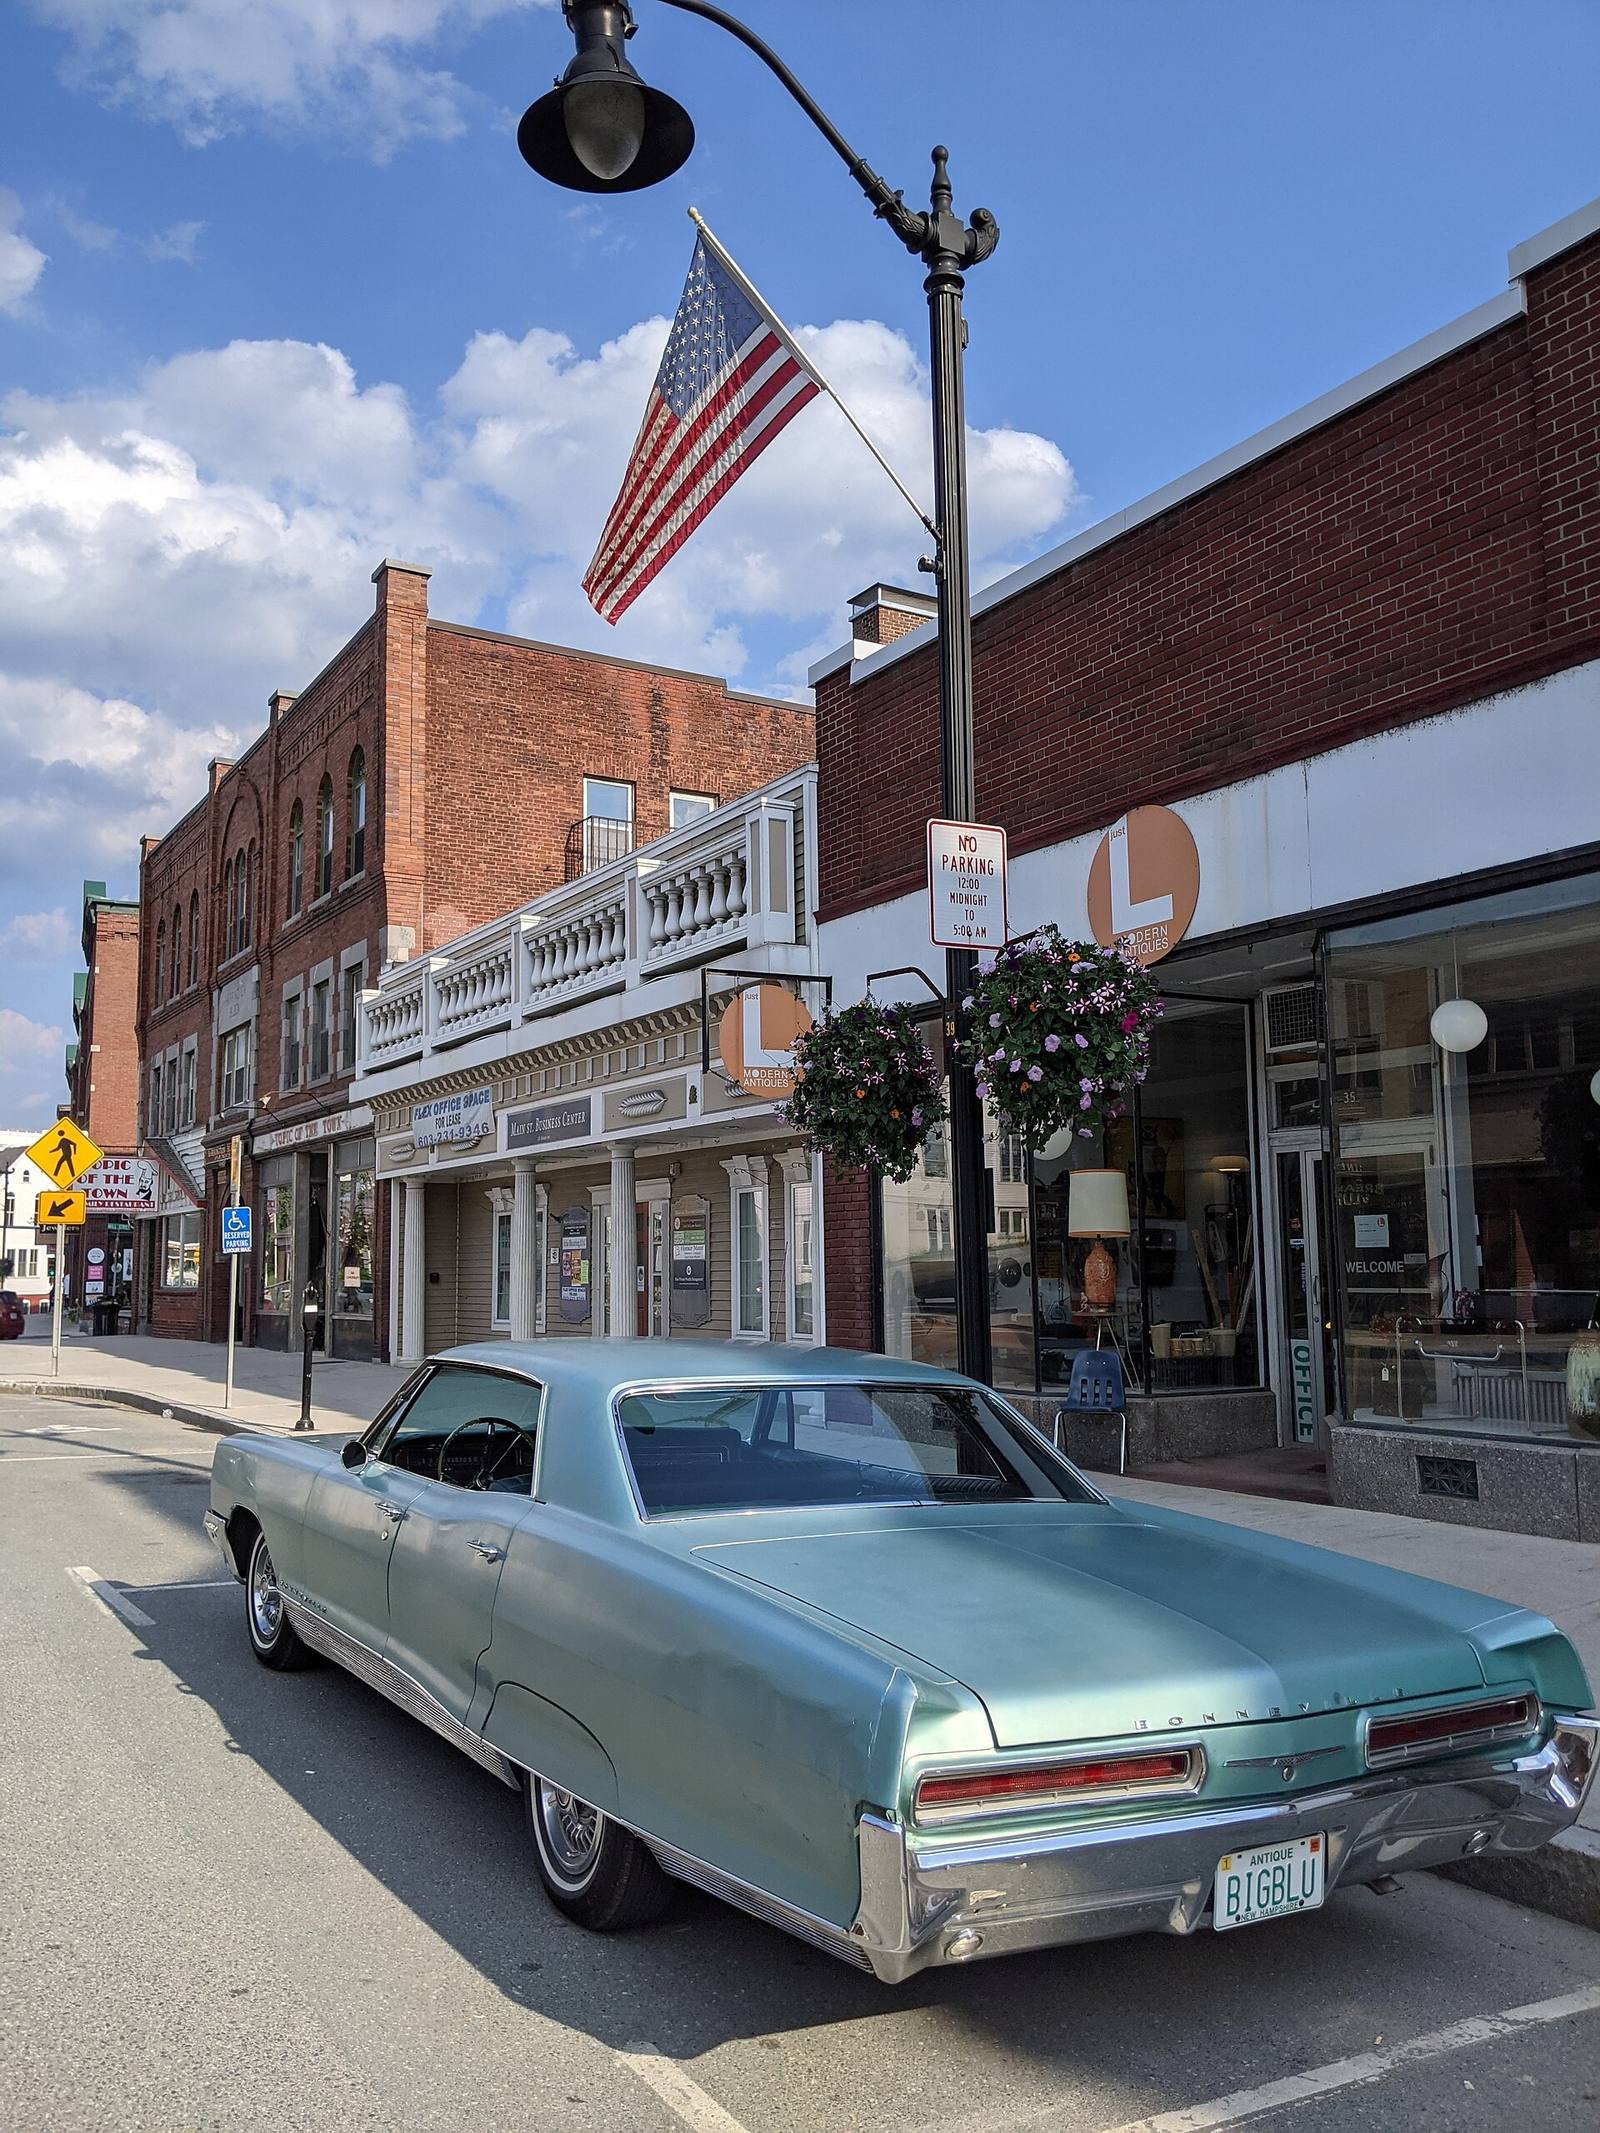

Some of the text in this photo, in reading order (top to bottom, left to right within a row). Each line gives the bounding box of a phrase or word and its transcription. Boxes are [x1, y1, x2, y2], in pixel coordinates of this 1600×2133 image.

[1110, 826, 1126, 841] just
[958, 835, 978, 853] NO
[942, 854, 994, 876] PARKING
[957, 877, 980, 890] 12:00
[949, 891, 988, 907] MIDNIGHT
[964, 909, 975, 921] TO
[953, 924, 987, 938] 5:00 AM
[1127, 924, 1168, 945] ODERN
[1125, 937, 1169, 957] NTIQUES
[744, 991, 759, 1001] just
[743, 1069, 789, 1079] MODERN
[743, 1079, 789, 1088] ANTIQUES
[433, 1096, 462, 1116] OFFICE
[463, 1089, 490, 1109] SPACE
[435, 1112, 461, 1130] FOR LEASE
[418, 1122, 490, 1147] 603-231-9346
[92, 1160, 131, 1171] OPIC
[77, 1174, 134, 1184] OF THE
[81, 1188, 128, 1199] TOWN
[224, 1231, 250, 1240] RESERVED
[225, 1239, 249, 1248] PARKING
[1345, 1260, 1405, 1273] WELCOME
[1294, 1345, 1314, 1437] OFFICE
[1250, 1848, 1294, 1867] ANTIQUE
[1227, 1858, 1315, 1917] BIGBLU
[1241, 1901, 1299, 1921] NEW HAMPSHIRE
